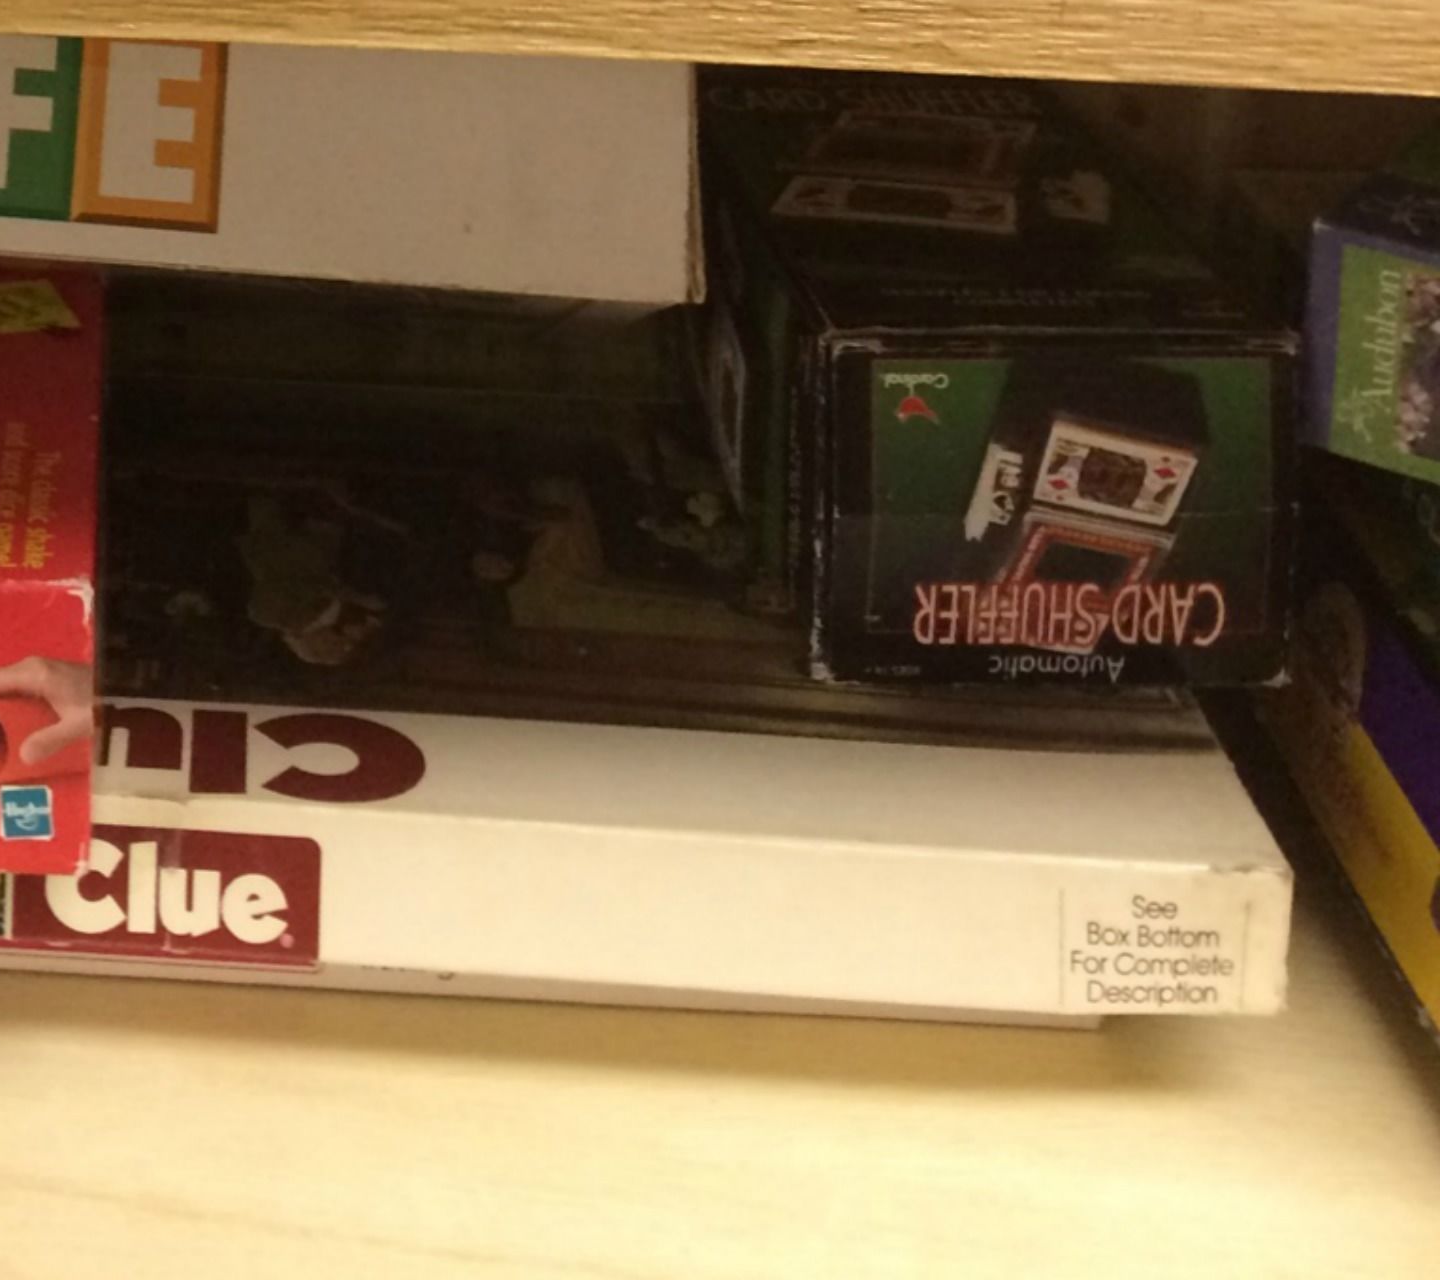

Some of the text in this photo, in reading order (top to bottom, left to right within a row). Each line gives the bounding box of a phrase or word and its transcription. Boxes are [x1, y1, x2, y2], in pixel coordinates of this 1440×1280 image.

[1361, 270, 1401, 414] Audubon
[22, 527, 55, 568] shake
[913, 583, 1226, 646] CARD SHUFFLER
[988, 654, 1125, 683] Automatic
[44, 838, 289, 944] Clue
[1131, 894, 1179, 919] See
[1086, 921, 1220, 948] Box Bottom
[1070, 950, 1234, 979] For Complete
[1086, 980, 1217, 1007] Description
